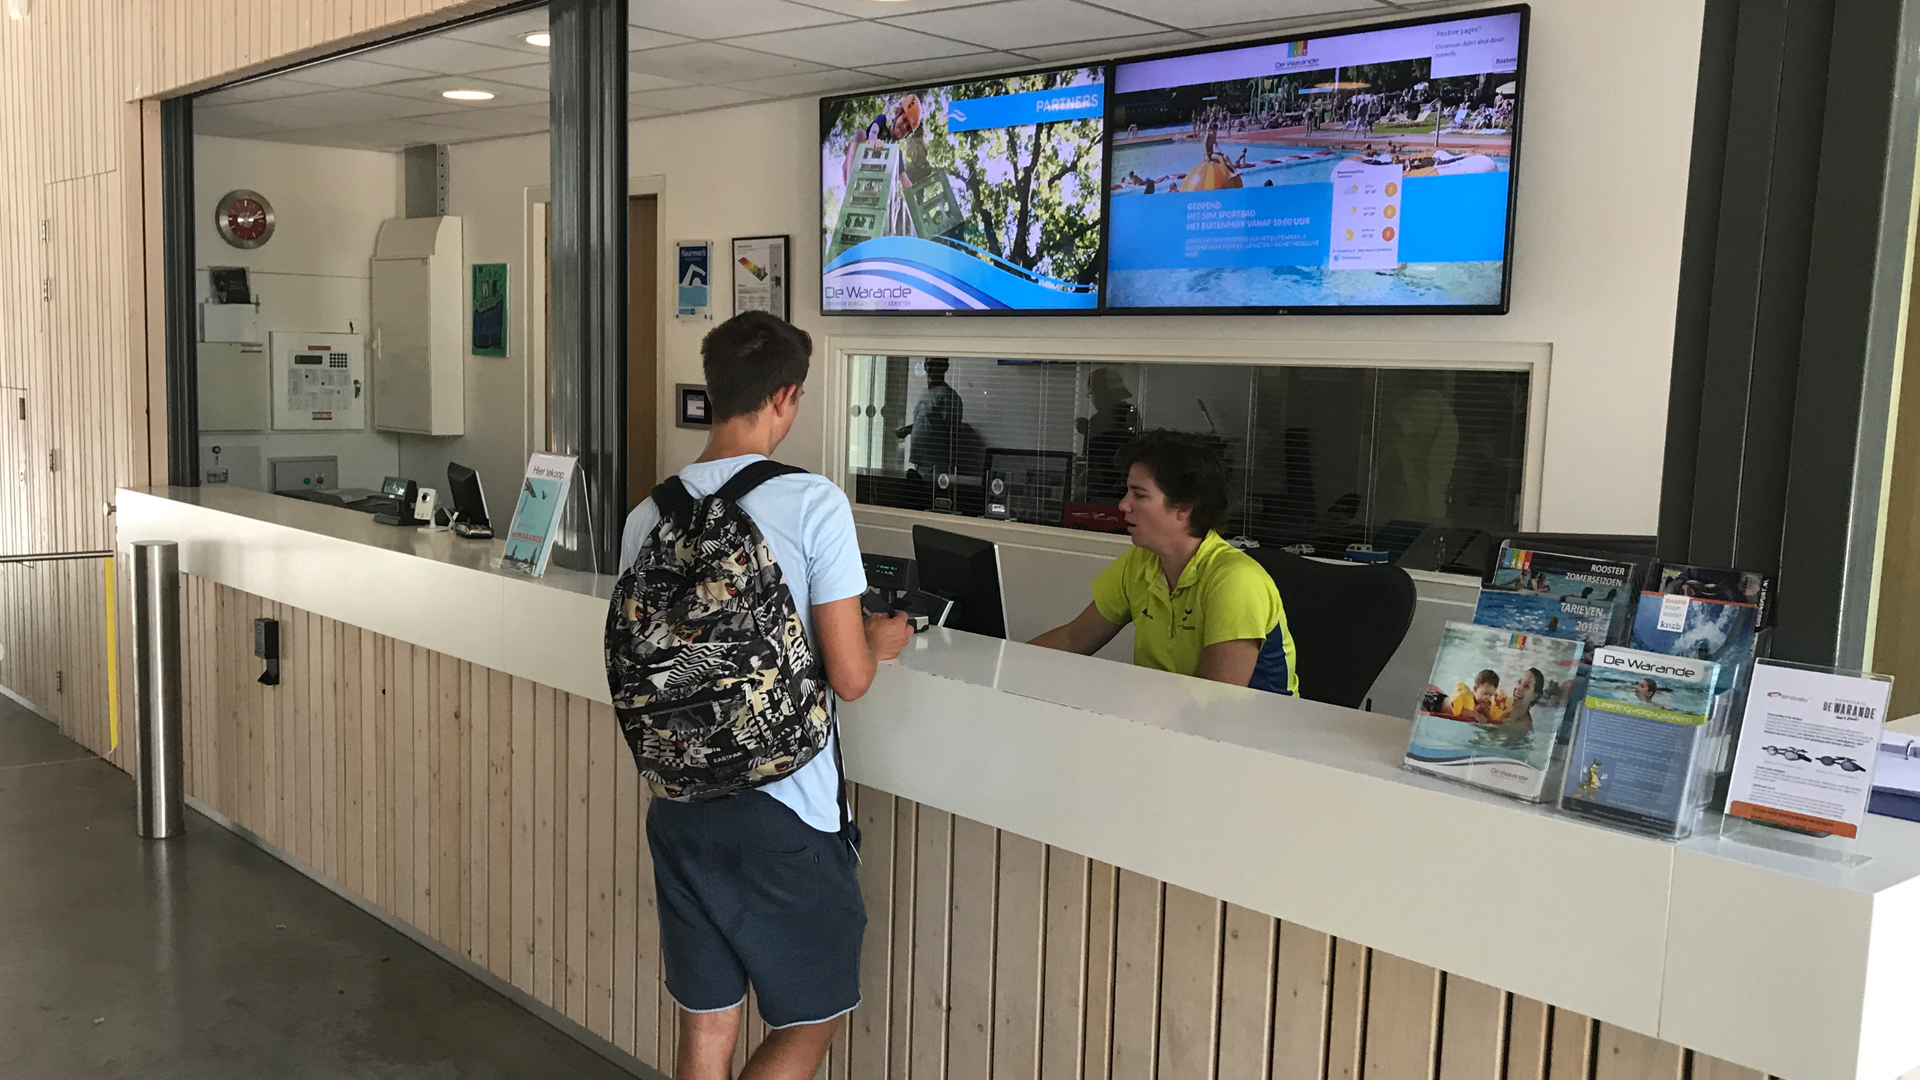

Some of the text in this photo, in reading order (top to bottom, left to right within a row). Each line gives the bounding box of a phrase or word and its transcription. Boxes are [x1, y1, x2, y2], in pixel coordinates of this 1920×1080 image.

[1036, 94, 1099, 113] PARTNERS
[1187, 212, 1201, 220] HET
[1218, 209, 1256, 219] SPORTBAD
[1186, 223, 1200, 231] HET
[1201, 220, 1246, 230] BUITENPARK
[1247, 218, 1272, 227] VANAF
[1293, 217, 1310, 226] UUR
[825, 286, 912, 299] De Warande
[1591, 564, 1625, 575] ROOSTER
[1565, 572, 1623, 587] ZOMERSEIZOEN
[1560, 602, 1604, 617] TARIEVEN
[1575, 620, 1600, 633] 2018
[1603, 654, 1696, 678] De Warande
[1823, 701, 1833, 712] DE
[1833, 702, 1877, 720] WARANDE
[713, 751, 743, 763] EASTPAK
[1500, 771, 1529, 782] Warande
